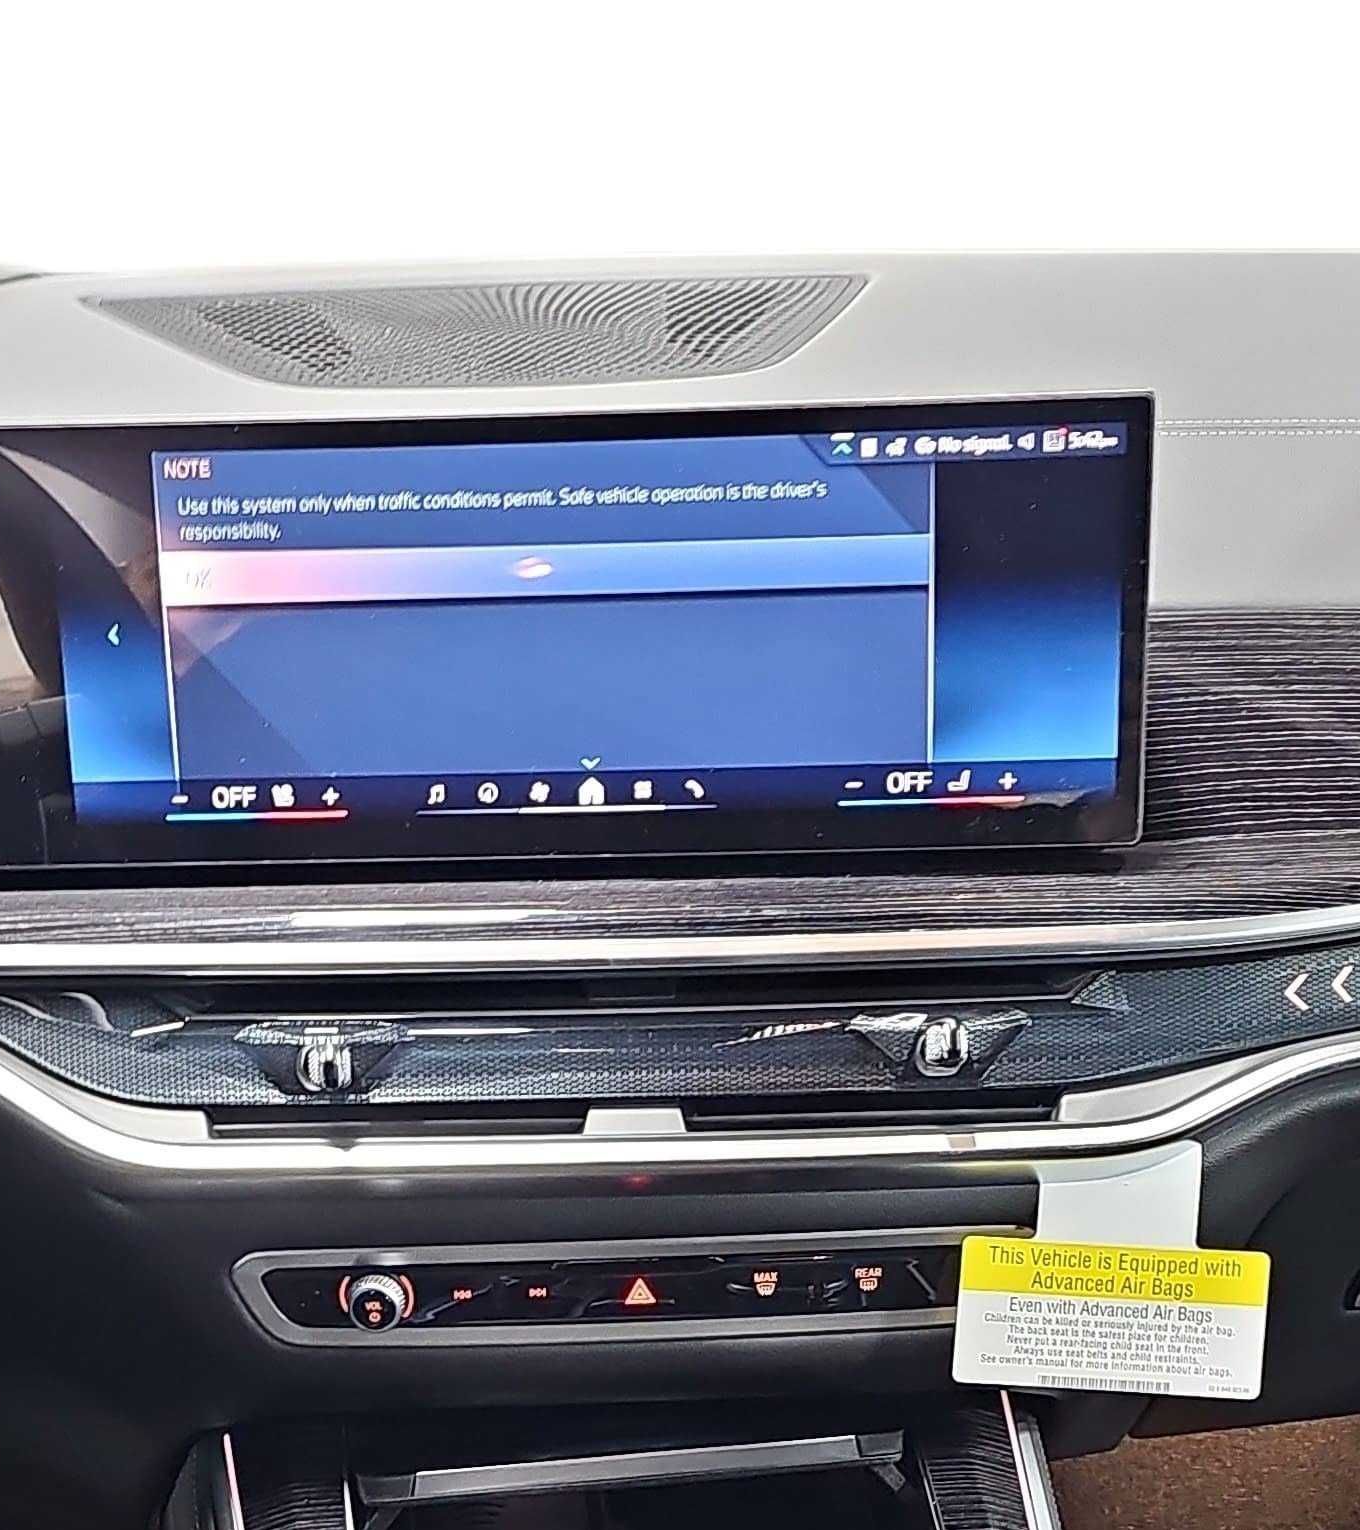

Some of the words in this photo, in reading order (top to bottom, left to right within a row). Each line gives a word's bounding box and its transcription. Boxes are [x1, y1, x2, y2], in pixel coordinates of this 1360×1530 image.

[937, 436, 962, 453] No
[163, 457, 211, 479] NOTE
[177, 496, 209, 516] Use
[211, 494, 239, 515] this
[241, 495, 296, 517] system
[298, 493, 330, 516] only
[332, 491, 375, 512] when
[378, 490, 421, 511] traffic
[423, 488, 500, 510] conditions
[503, 487, 557, 511] permit.
[558, 485, 594, 506] Safe
[595, 484, 648, 505] vehicle
[650, 483, 725, 506] operation
[725, 482, 741, 501] is
[741, 480, 769, 501] the
[769, 478, 827, 500] driver's
[179, 520, 282, 544] responsibility.
[886, 770, 933, 794] OFF
[211, 785, 257, 809] OFF
[854, 1267, 883, 1279] REAR
[989, 1246, 1024, 1265] This
[1031, 1248, 1092, 1269] Vehicle
[1098, 1252, 1112, 1270] is
[1119, 1253, 1199, 1277] Equipped
[1205, 1259, 1241, 1277] with
[753, 1271, 779, 1283] MAX
[1031, 1271, 1115, 1293] Advanced
[1120, 1276, 1146, 1295] Air
[1152, 1278, 1194, 1300] Bags
[364, 1301, 383, 1311] VOL
[1009, 1296, 1042, 1313] Even
[1046, 1299, 1076, 1315] with
[1080, 1301, 1149, 1319] Advanced
[1152, 1305, 1174, 1321] Air
[1178, 1306, 1213, 1325] Bags
[984, 1312, 1021, 1323] Children
[1023, 1316, 1040, 1325] can
[1042, 1316, 1053, 1325] be
[1055, 1317, 1079, 1327] killed
[1081, 1319, 1092, 1327] or
[1094, 1319, 1134, 1332] seriously
[1171, 1323, 1182, 1335] by
[1184, 1325, 1198, 1334] the
[1201, 1326, 1214, 1335] air
[1216, 1327, 1236, 1337] bag.
[1009, 1325, 1024, 1335] The
[1027, 1326, 1047, 1335] back
[1050, 1327, 1068, 1337] seat
[1082, 1328, 1096, 1338] the
[1098, 1329, 1125, 1340] safest
[1128, 1332, 1151, 1342] place
[1154, 1333, 1166, 1342] for
[1169, 1334, 1209, 1345] children.
[1007, 1335, 1032, 1345] Never
[1035, 1337, 1049, 1347] put
[1060, 1338, 1107, 1350] rear-facing
[1110, 1340, 1132, 1351] child
[1135, 1343, 1154, 1352] seat
[1167, 1344, 1181, 1353] the
[1013, 1345, 1044, 1357] Always
[1047, 1348, 1063, 1357] use
[1065, 1348, 1084, 1358] seat
[1087, 1349, 1108, 1359] belts
[1110, 1351, 1127, 1361] and
[1130, 1351, 1151, 1362] child
[1154, 1353, 1201, 1365] restraints.
[980, 1353, 996, 1363] See
[999, 1356, 1033, 1366] owner's
[1036, 1358, 1067, 1368] manual
[1070, 1359, 1083, 1368] for
[1086, 1361, 1108, 1370] more
[1165, 1364, 1191, 1374] about
[1193, 1367, 1206, 1376] air
[1209, 1367, 1233, 1378] bags.
